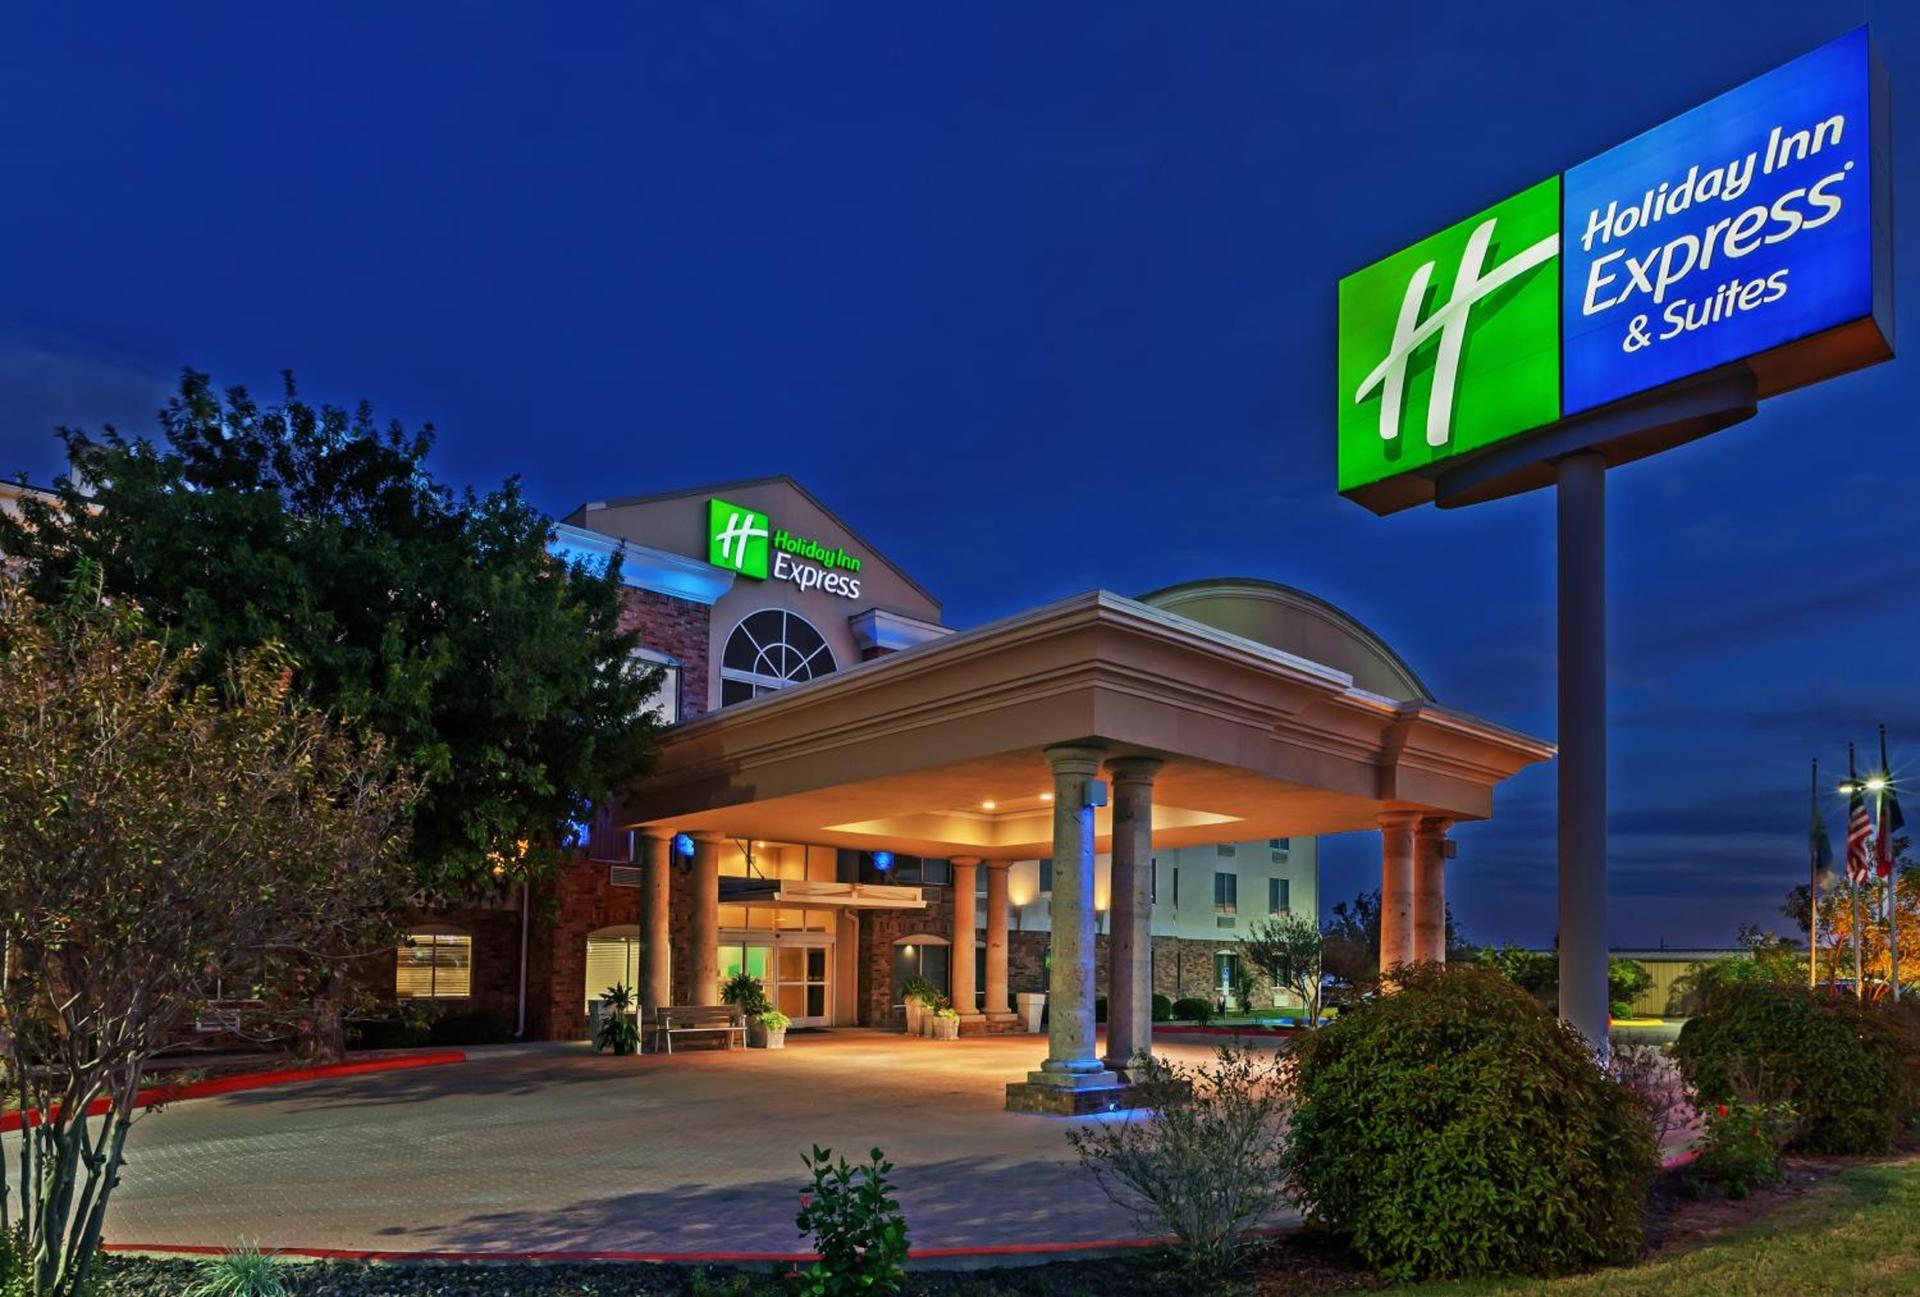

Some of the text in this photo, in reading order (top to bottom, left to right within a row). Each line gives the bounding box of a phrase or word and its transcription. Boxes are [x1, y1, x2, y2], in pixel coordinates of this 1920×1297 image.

[1581, 115, 1845, 252] Holiday Inn
[1582, 171, 1846, 316] Express
[1622, 269, 1789, 353] & Suites
[773, 551, 861, 599] Express
[774, 530, 861, 571] Holiday Inn
